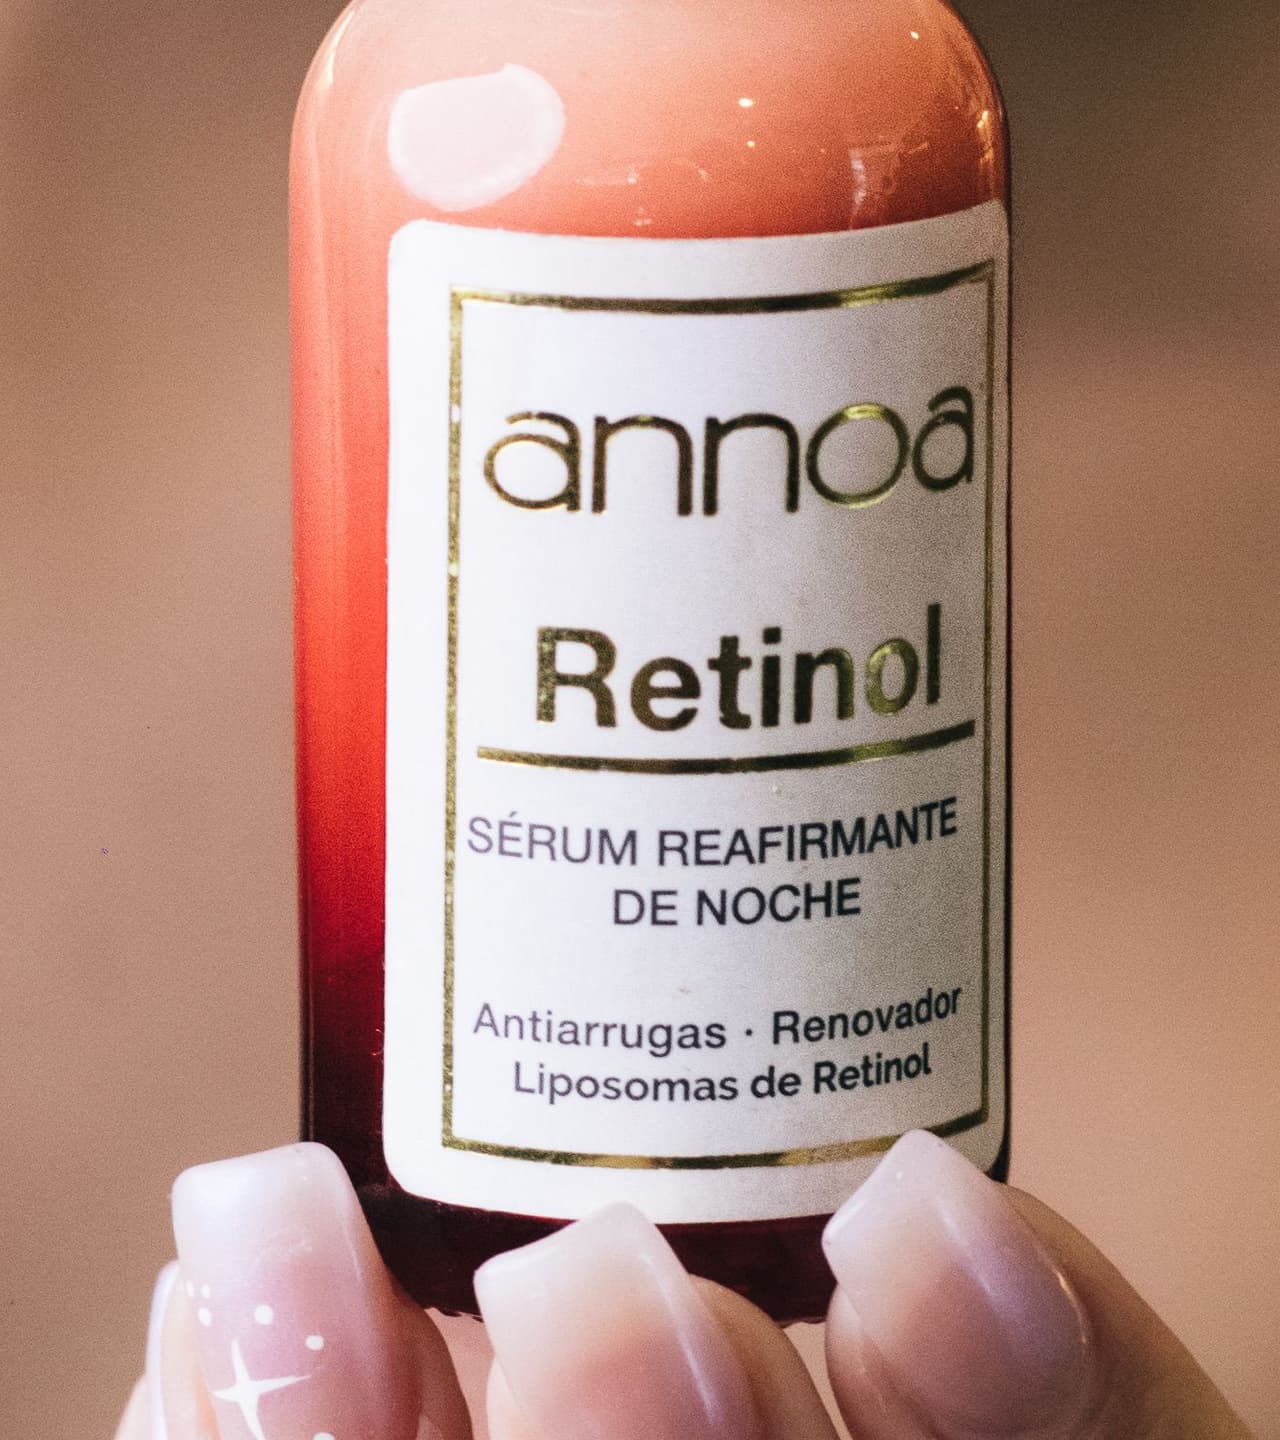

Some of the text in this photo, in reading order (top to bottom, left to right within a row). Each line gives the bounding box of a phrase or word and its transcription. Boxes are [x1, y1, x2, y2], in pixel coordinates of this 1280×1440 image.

[483, 384, 975, 517] annoa
[534, 602, 942, 733] Retinol
[467, 796, 959, 867] SÉRUM REAFIRMANTE
[613, 877, 862, 927] DE NOCHE
[472, 1001, 728, 1058] Antiarrugas
[771, 986, 963, 1046] Renovador
[513, 1043, 933, 1105] Liposomas de Retinol
